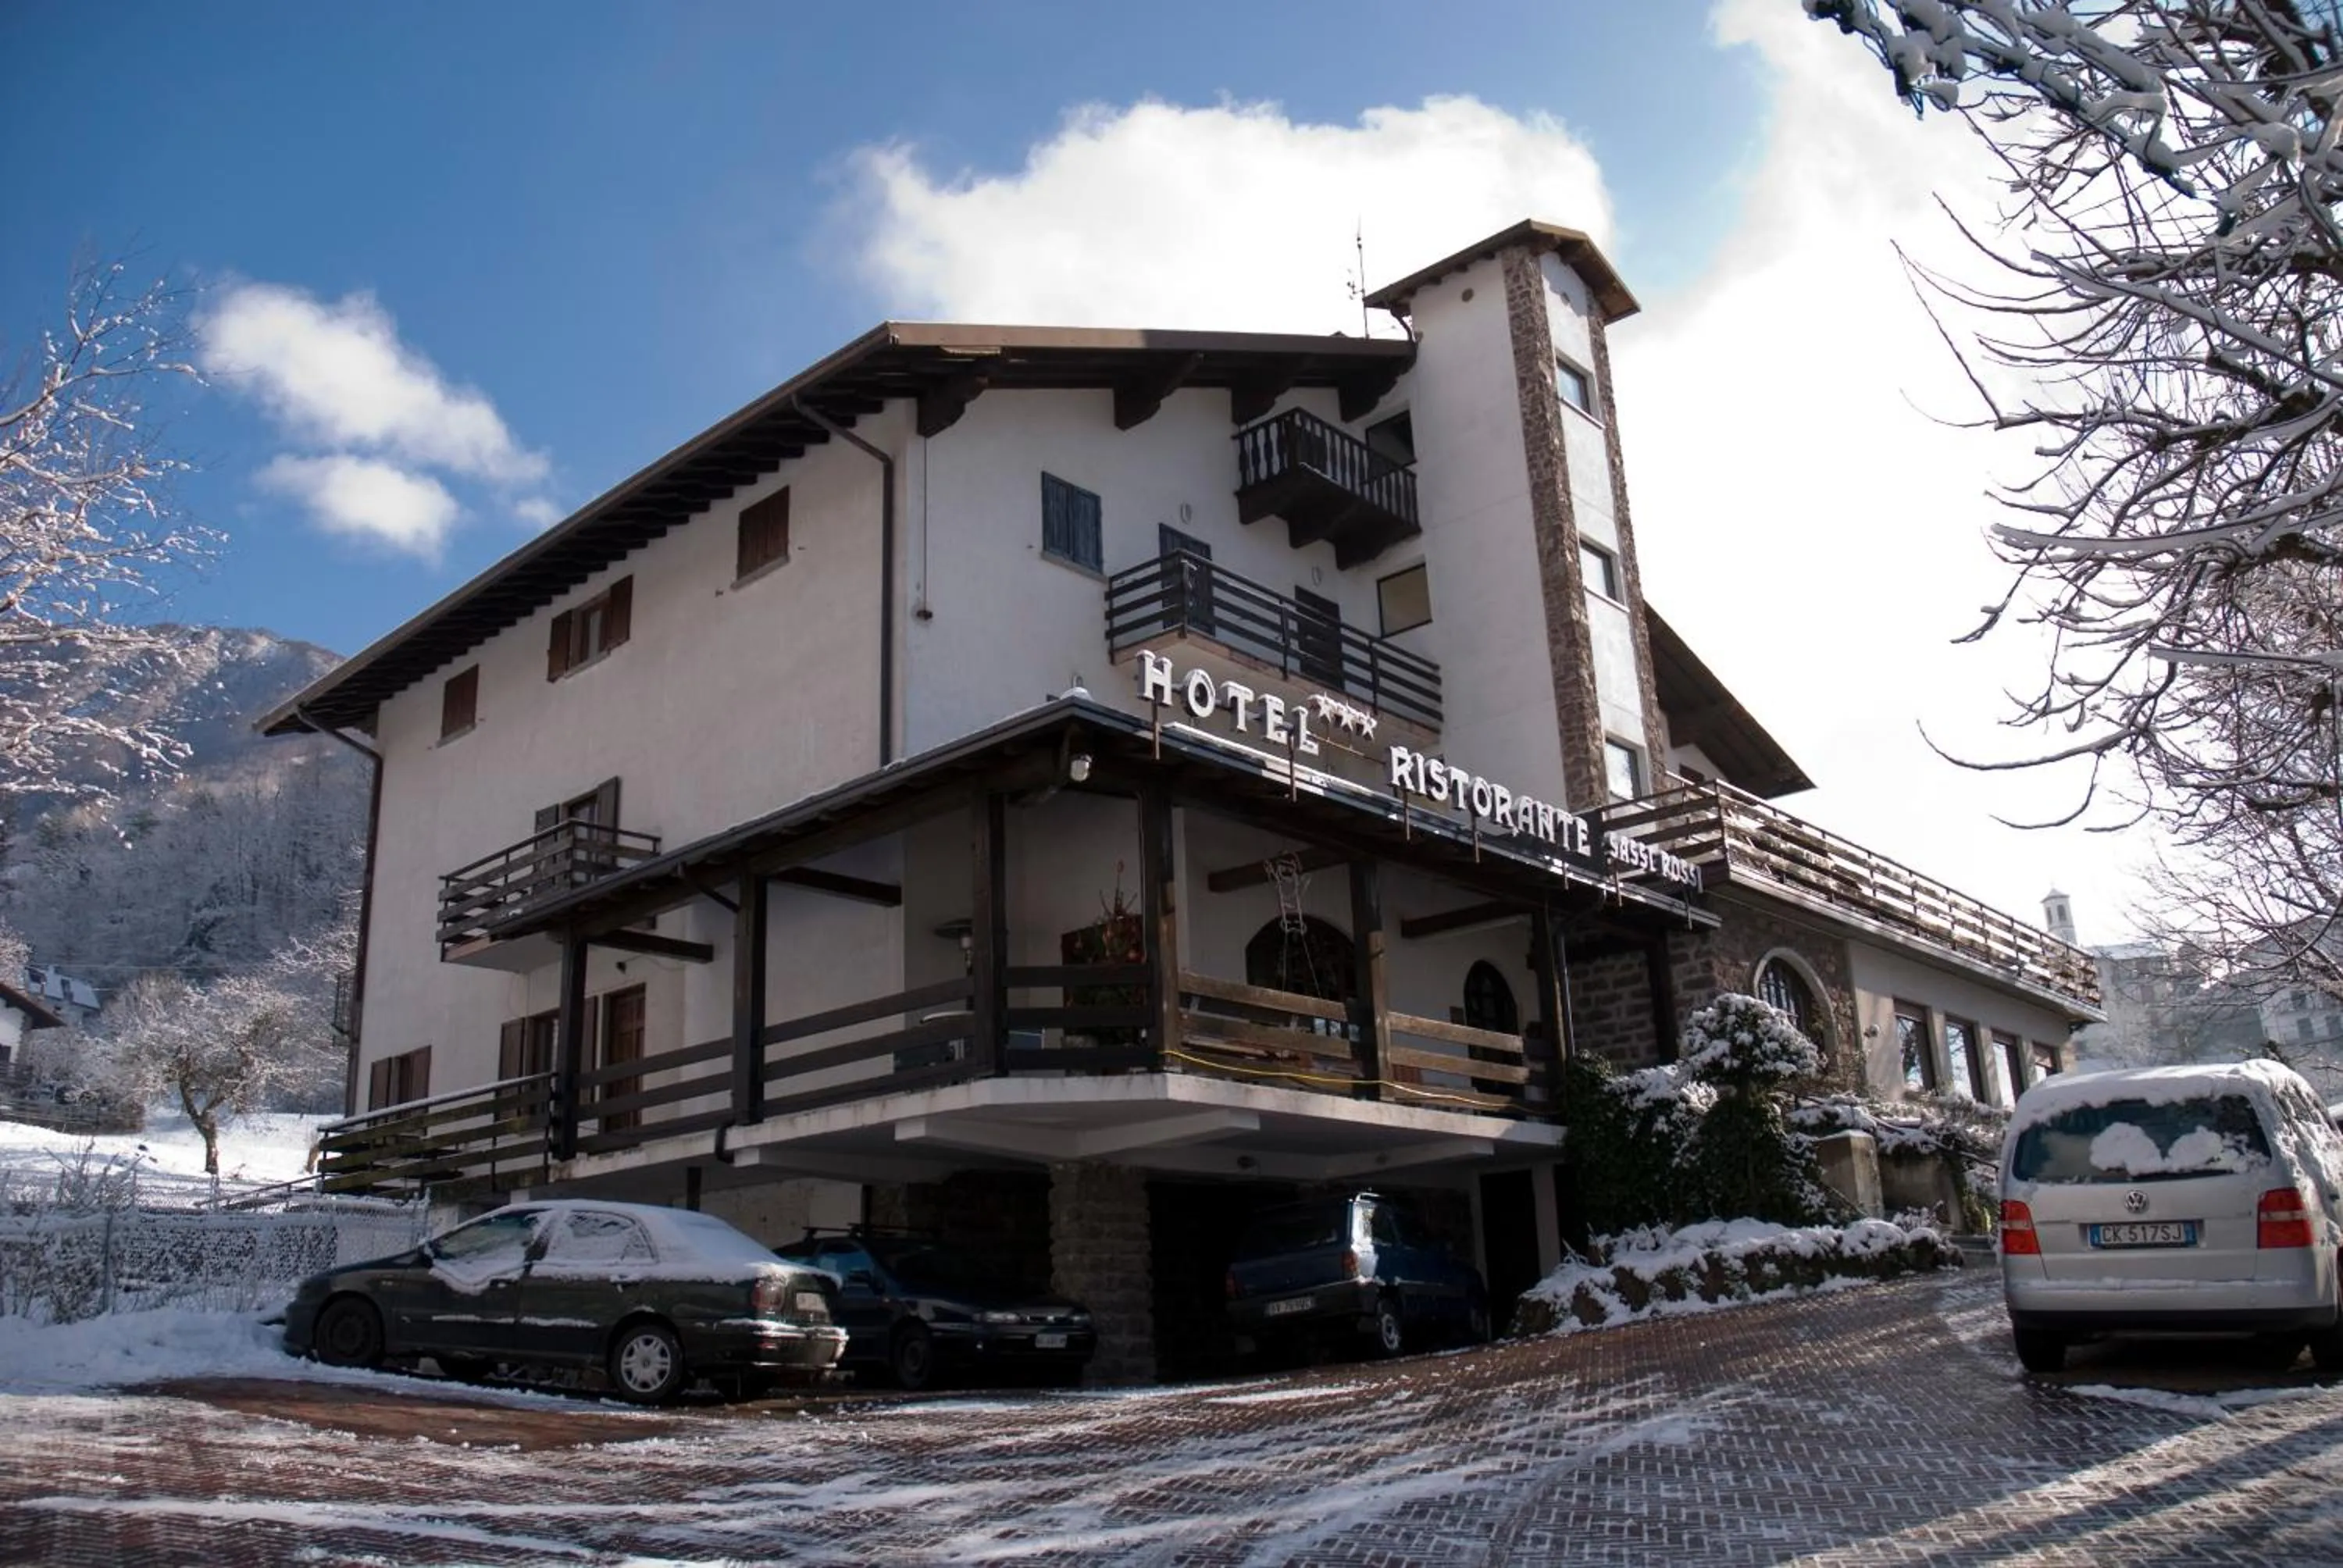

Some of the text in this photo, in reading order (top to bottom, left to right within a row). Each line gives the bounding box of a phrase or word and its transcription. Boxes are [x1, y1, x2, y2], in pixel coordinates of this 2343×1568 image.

[1136, 650, 1320, 755] HOTEL
[1389, 746, 1592, 857] RISTORANTE
[1607, 832, 1704, 893] SASSI ROSSI
[2102, 1224, 2181, 1242] CK 517SJ
